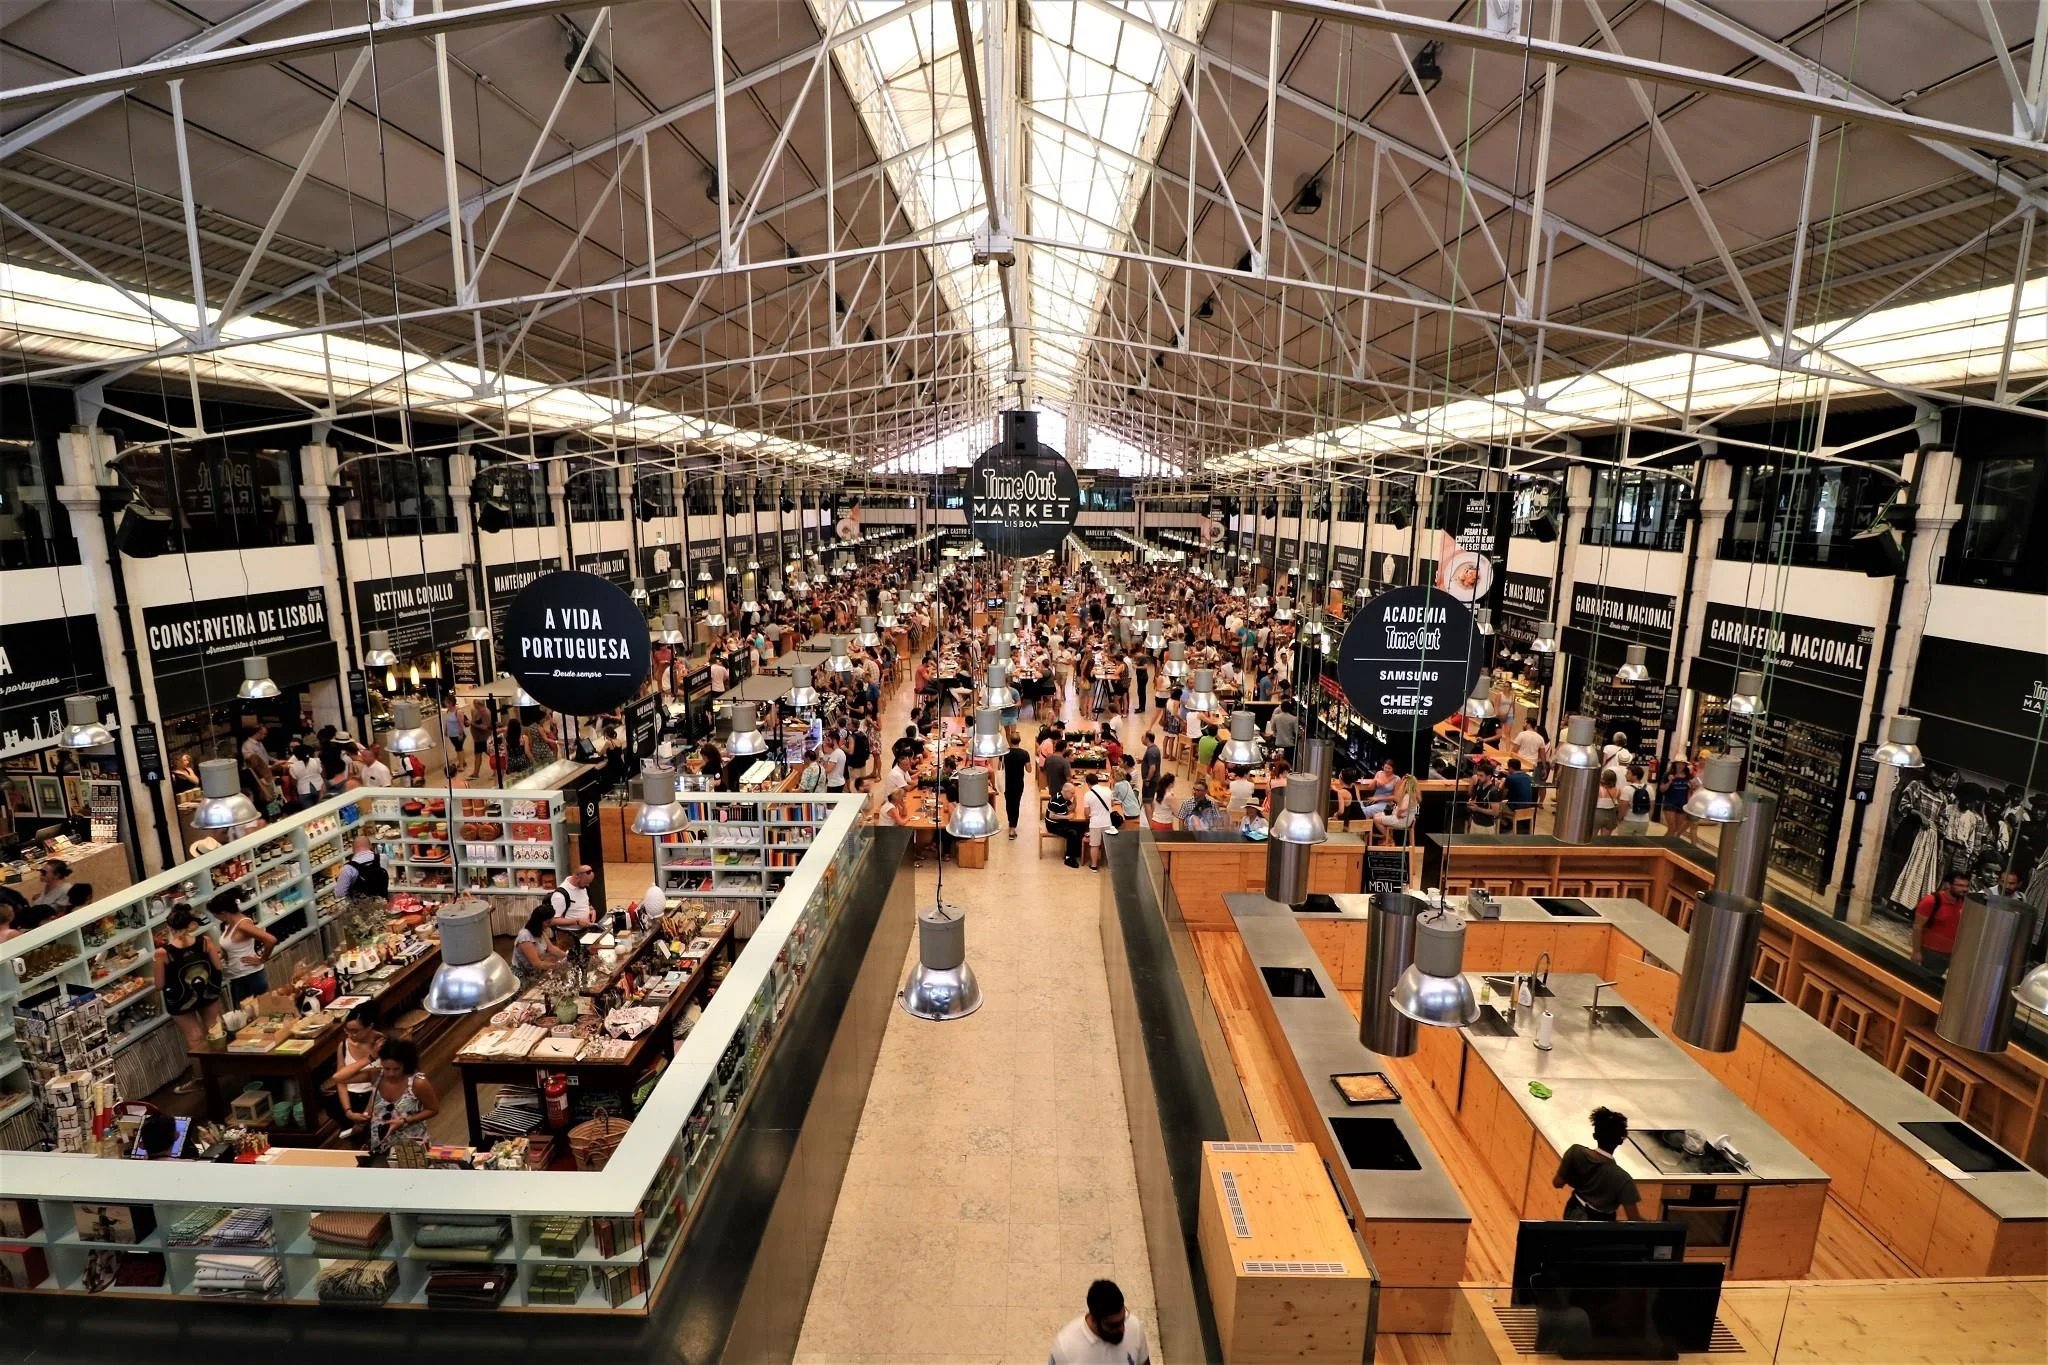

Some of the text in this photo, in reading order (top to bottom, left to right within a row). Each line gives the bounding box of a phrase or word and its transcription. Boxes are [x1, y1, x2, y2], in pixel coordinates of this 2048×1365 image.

[982, 468, 1057, 500] Time Out
[973, 503, 1070, 518] MARKET
[1004, 520, 1038, 528] LISBOA
[373, 583, 454, 613] BETTINA CORALLO
[1508, 583, 1524, 600] MAIS
[1524, 586, 1545, 604] BOLOS
[544, 608, 603, 630] A VIDA
[1382, 606, 1447, 624] ACADEMIA
[1575, 595, 1673, 630] GARRAFEIRA NACIONAL
[149, 602, 325, 651] CONSERVEIRA DE LISBOA
[521, 636, 631, 660] PORTUGUESA
[1710, 618, 1864, 671] GARRAFEIRA NACIONAL
[552, 669, 603, 679] Desde sempre
[1379, 670, 1439, 682] SAMSUNG
[4, 676, 61, 696] portugueses
[1380, 694, 1434, 707] CHEF'S
[1382, 708, 1429, 716] EXPERIENCE
[1368, 880, 1393, 893] MENU
